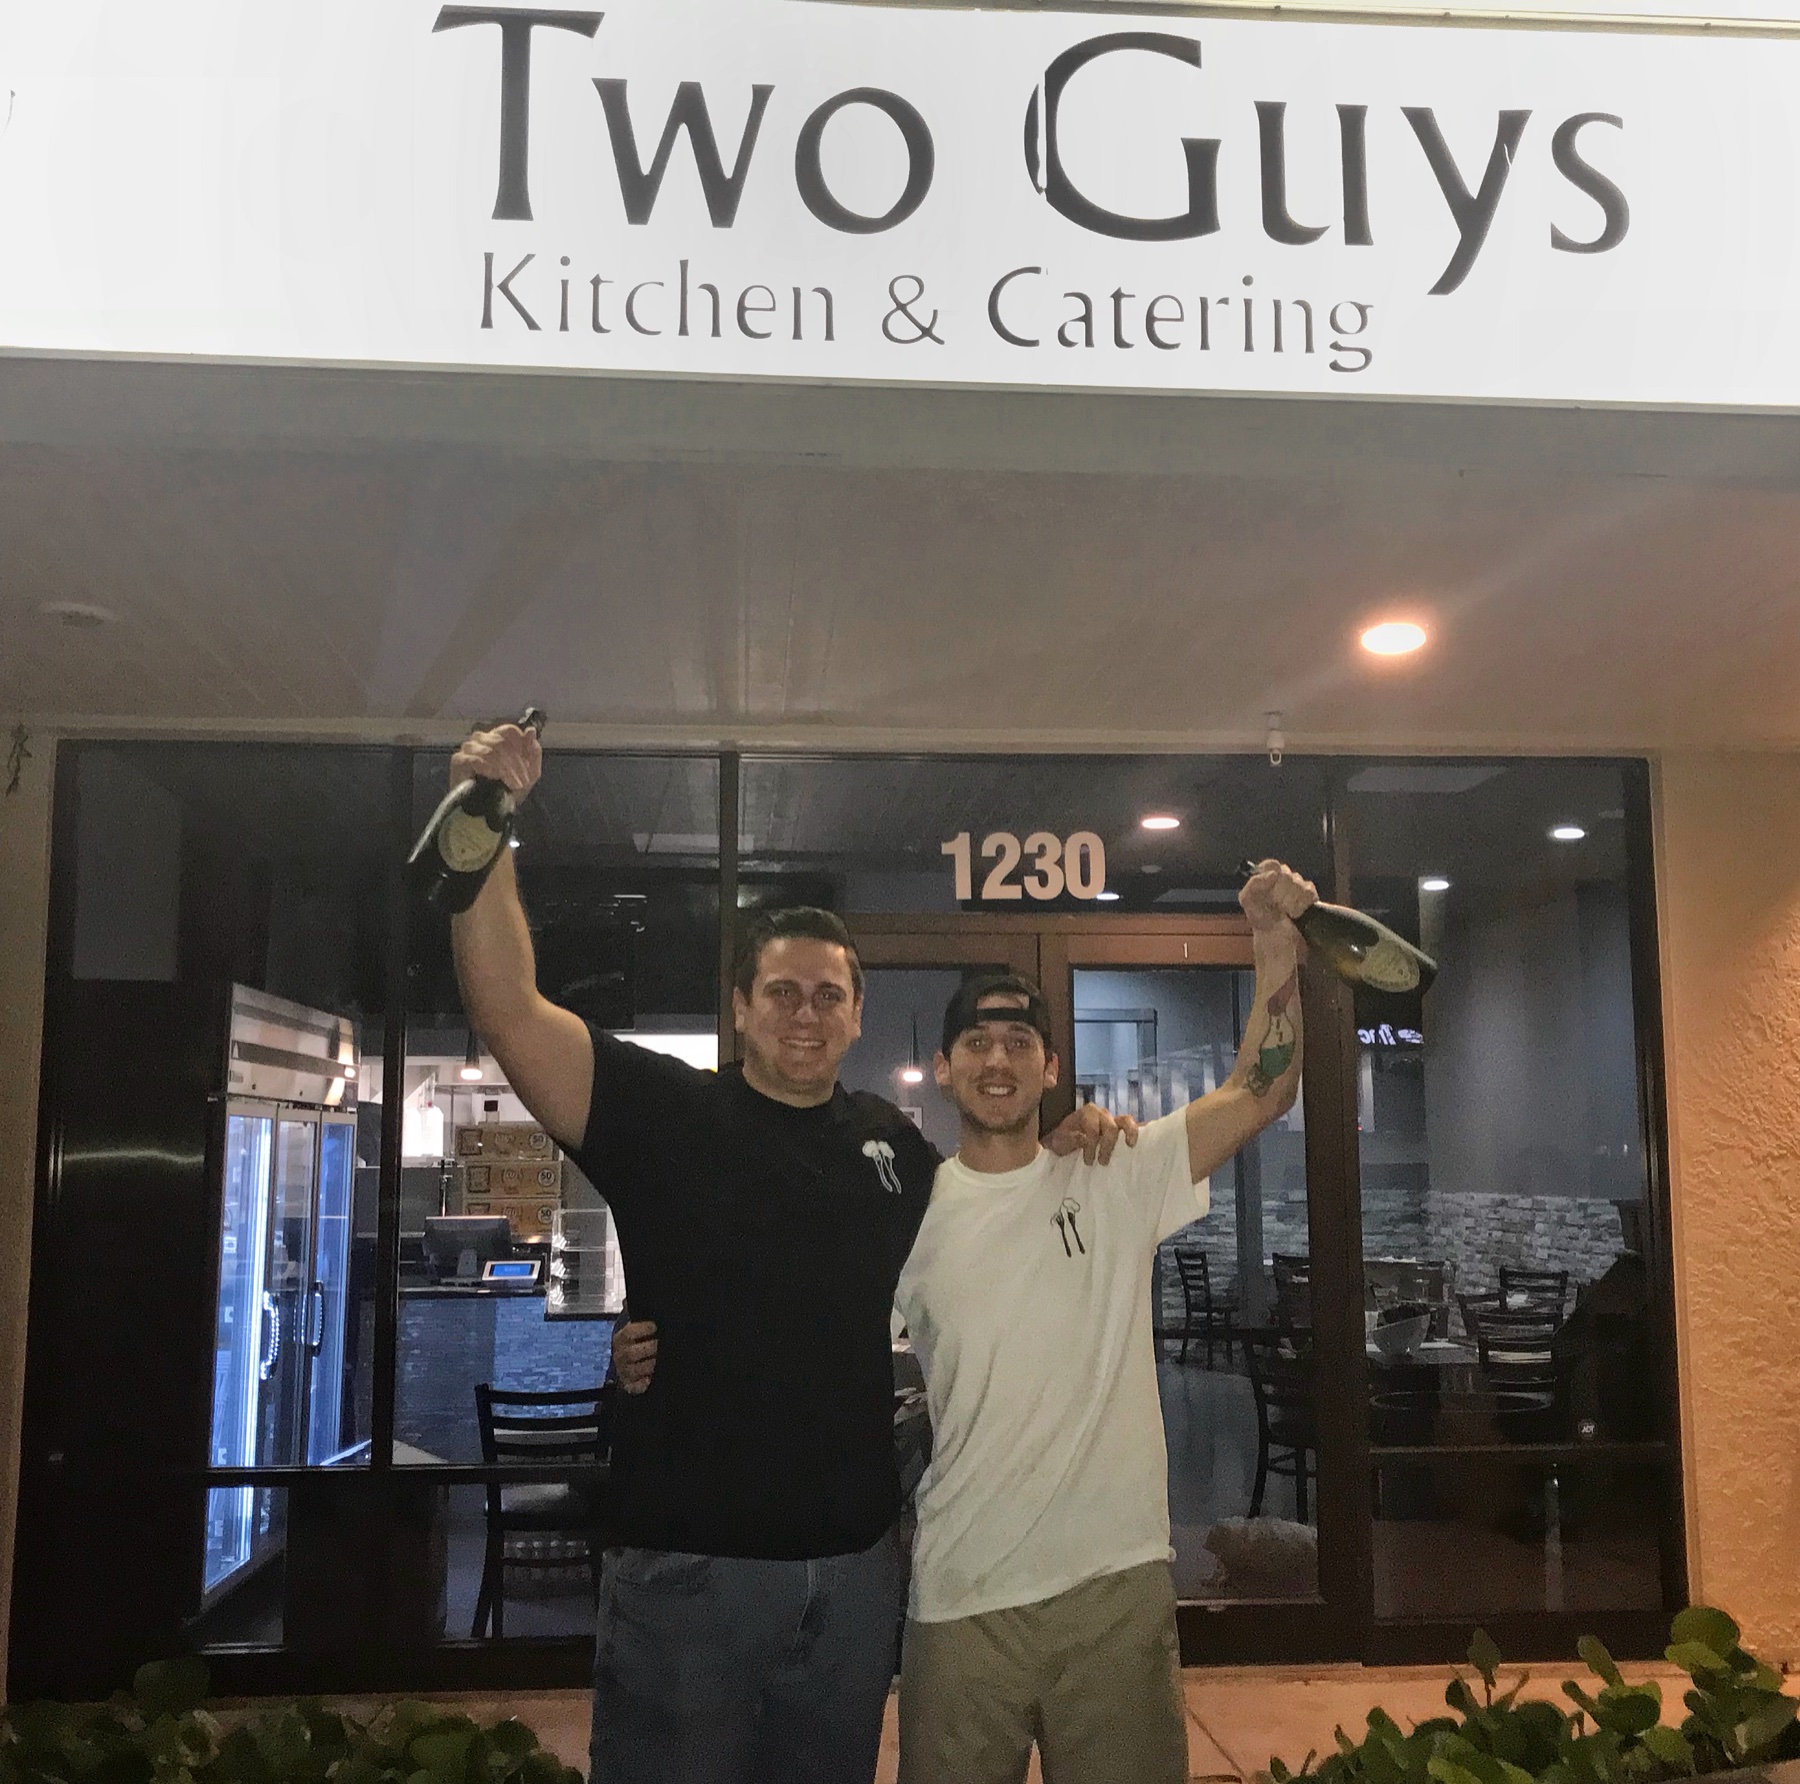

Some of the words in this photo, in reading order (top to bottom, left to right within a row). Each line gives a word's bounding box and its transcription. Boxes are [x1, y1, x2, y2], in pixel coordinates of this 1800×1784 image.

[432, 5, 934, 234] Two
[1024, 32, 1629, 296] Guys
[481, 253, 835, 342] Kitchen
[881, 274, 945, 346] &
[987, 266, 1375, 373] Catering
[941, 831, 1106, 900] 1230
